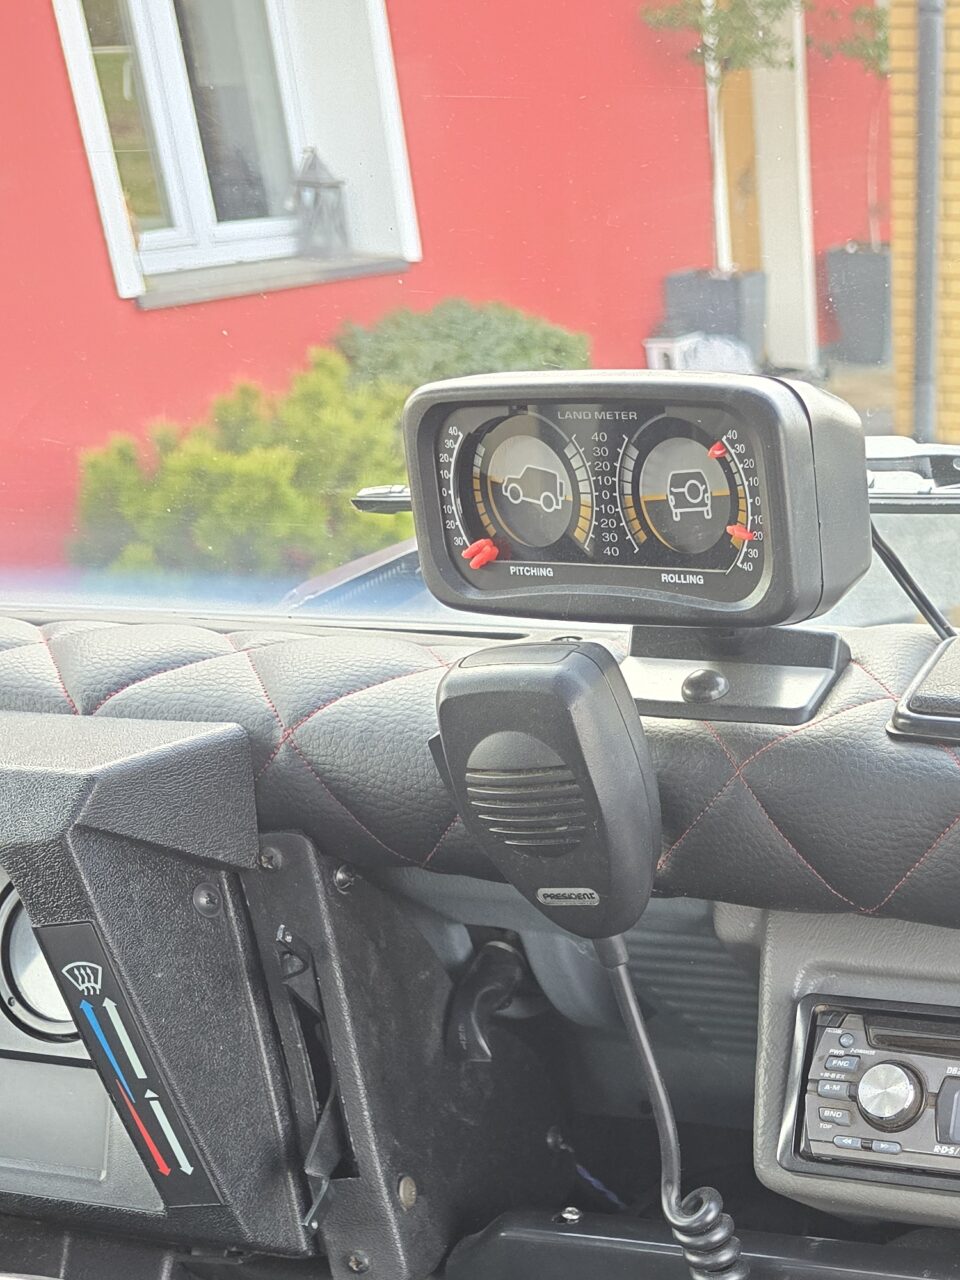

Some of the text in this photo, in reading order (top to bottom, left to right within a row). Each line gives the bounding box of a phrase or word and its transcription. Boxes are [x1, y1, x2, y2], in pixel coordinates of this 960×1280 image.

[557, 411, 638, 420] LAND METER
[448, 426, 458, 435] 40
[727, 430, 738, 440] 40
[591, 432, 608, 442] 40
[444, 440, 454, 449] 30
[592, 447, 609, 457] 30
[734, 445, 746, 454] 30
[439, 454, 449, 462] 20
[594, 462, 610, 471] 20
[743, 459, 754, 469] 20
[440, 470, 449, 479] 10
[598, 476, 612, 486] 10
[749, 477, 759, 487] 10
[442, 487, 447, 496] 0
[602, 490, 610, 500] 0
[755, 497, 761, 506] 0
[443, 505, 453, 514] 10
[601, 504, 615, 514] 10
[445, 520, 456, 529] 20
[600, 518, 617, 529] 20
[602, 532, 618, 543] 30
[752, 532, 763, 540] 20
[453, 536, 463, 546] 30
[603, 547, 619, 556] 40
[747, 549, 759, 558] 30
[742, 561, 753, 571] 40
[509, 566, 554, 577] PITCHING
[661, 573, 704, 584] ROLLING
[542, 892, 596, 900] PRESIDENT
